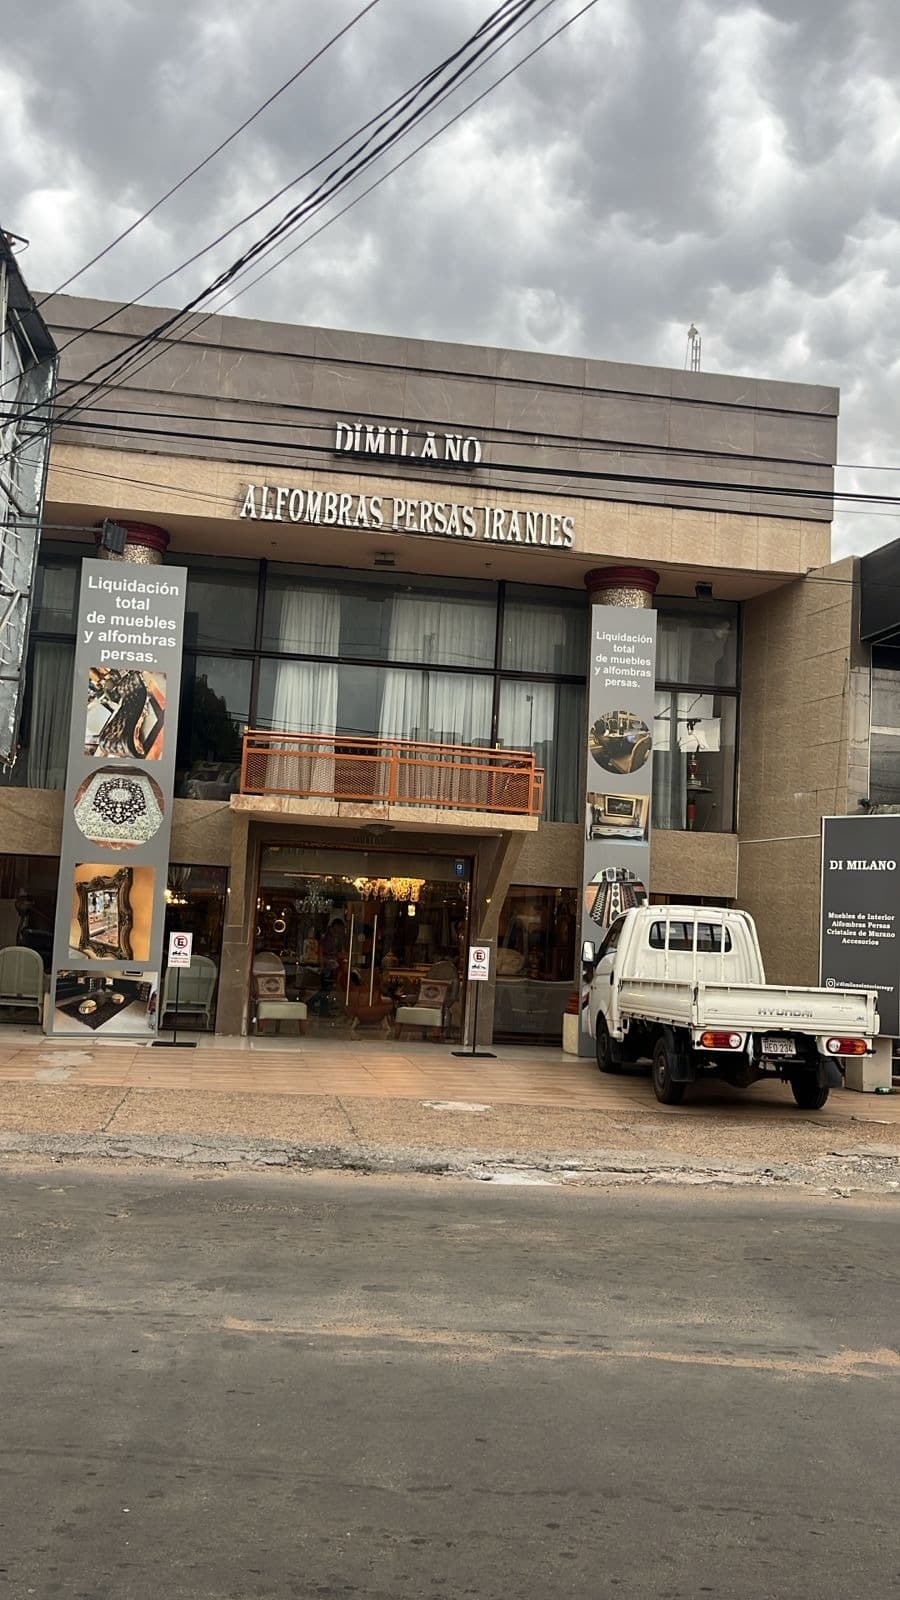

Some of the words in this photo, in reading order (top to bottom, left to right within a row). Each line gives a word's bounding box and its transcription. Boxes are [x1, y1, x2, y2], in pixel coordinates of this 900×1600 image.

[335, 421, 482, 464] DIMILANO
[240, 484, 383, 529] ALFOMBRAS
[392, 498, 477, 538] PERSAS
[484, 507, 576, 548] IRANIES
[88, 575, 179, 596] Liquidación
[116, 596, 150, 611] total
[86, 611, 106, 624] de
[110, 615, 177, 630] muebles
[83, 630, 94, 643] y
[98, 629, 177, 647] alfombras
[596, 631, 653, 643] Liquidación
[613, 644, 635, 653] total
[100, 649, 158, 663] persas.
[596, 654, 608, 663] de
[610, 656, 651, 666] muebles
[594, 666, 601, 676] y
[603, 666, 651, 677] alfombras
[605, 678, 640, 688] persas.
[829, 860, 843, 870] DI
[846, 860, 897, 871] MILANO
[867, 913, 895, 921] Interior
[831, 920, 866, 928] Alfombras
[868, 921, 891, 929] Persas
[826, 928, 857, 936] Cristales
[858, 929, 867, 937] de
[868, 930, 896, 938] Murano
[841, 937, 880, 946] Accesorios
[757, 1007, 813, 1018] HYUNDAI
